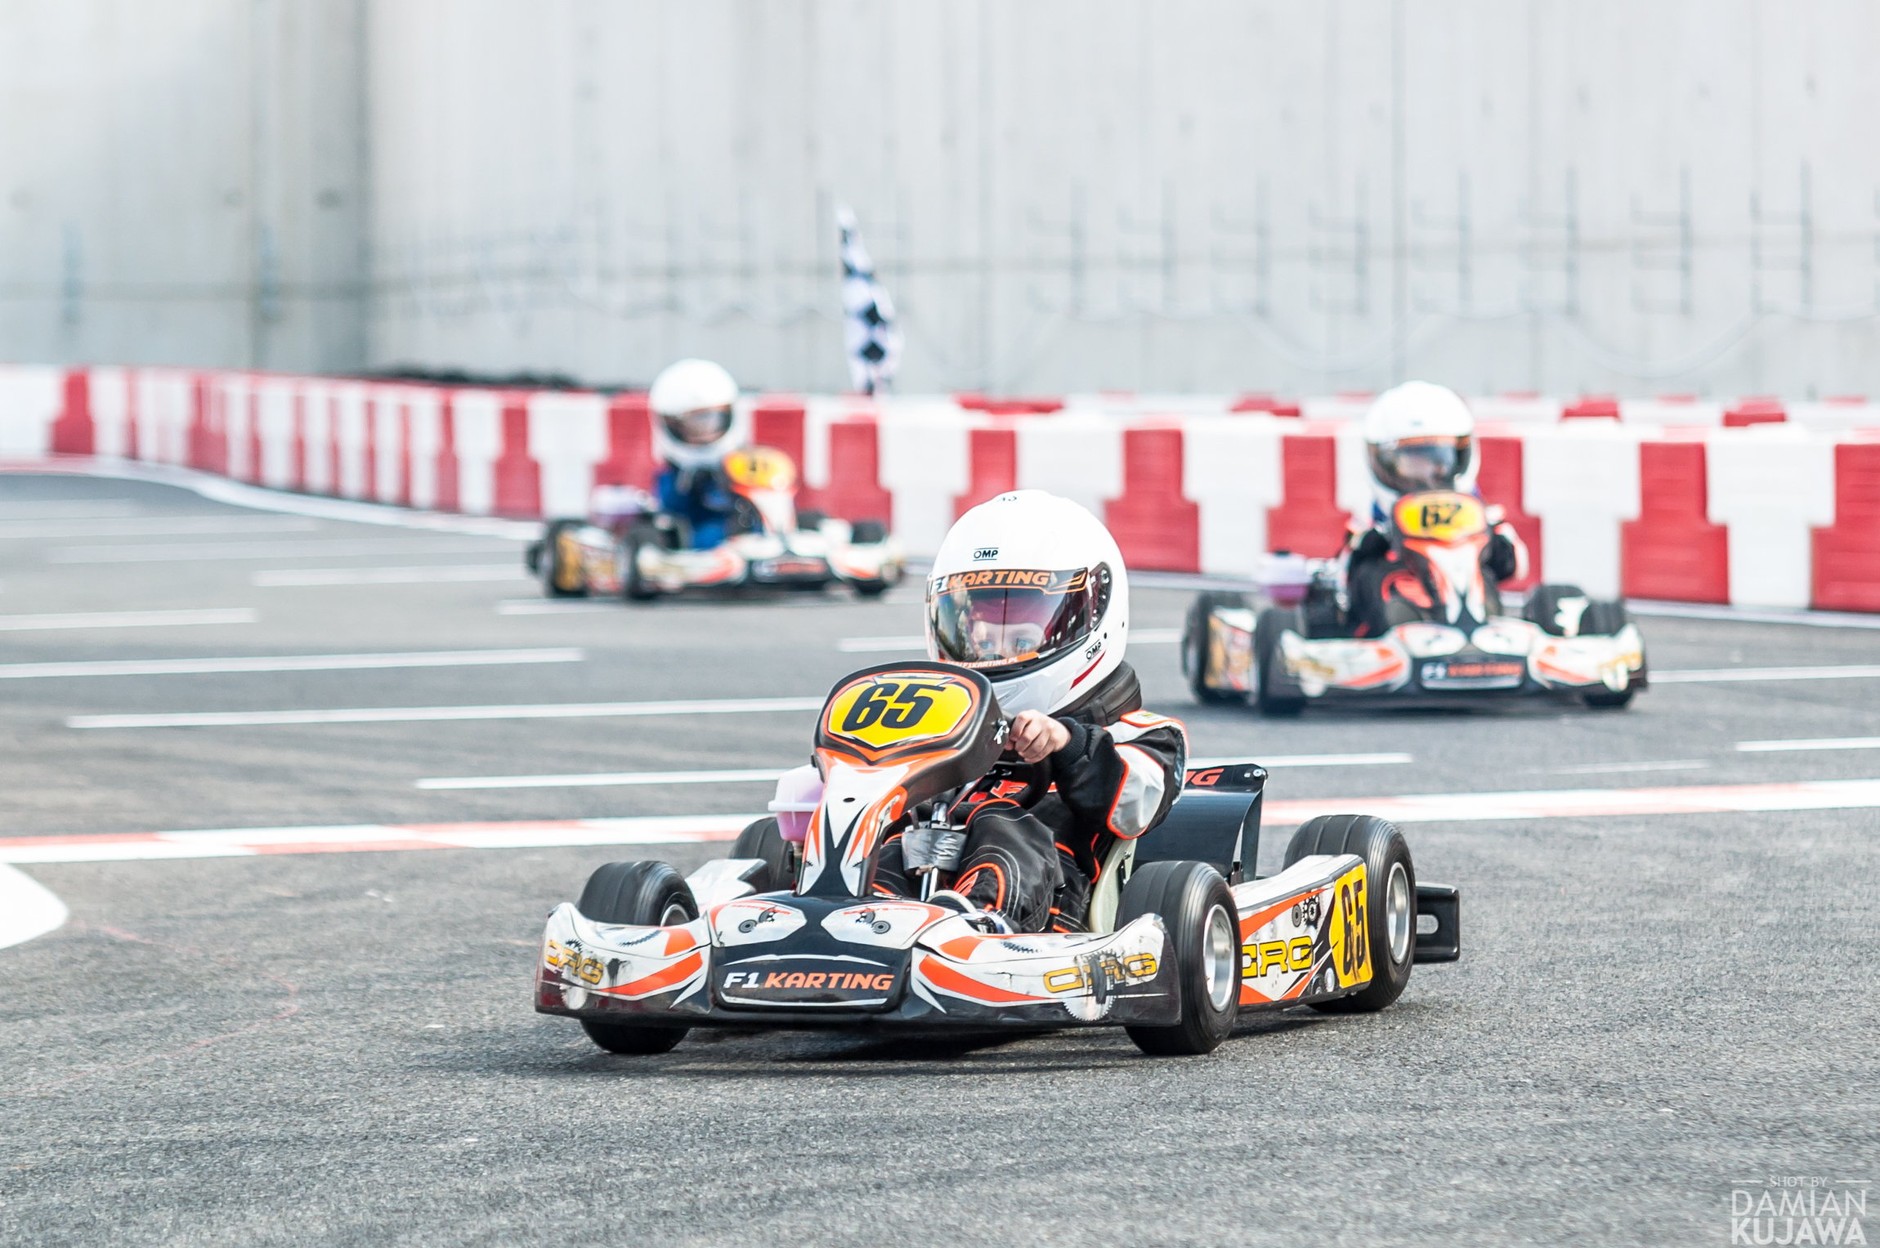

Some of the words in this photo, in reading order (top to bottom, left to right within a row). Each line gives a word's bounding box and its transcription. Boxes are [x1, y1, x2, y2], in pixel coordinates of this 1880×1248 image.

[973, 549, 999, 560] OMP
[947, 570, 1051, 588] KARTING
[1086, 641, 1102, 660] OMP
[842, 683, 946, 732] 65
[1341, 878, 1366, 976] 65
[723, 971, 760, 989] F1
[764, 972, 896, 991] KARTING
